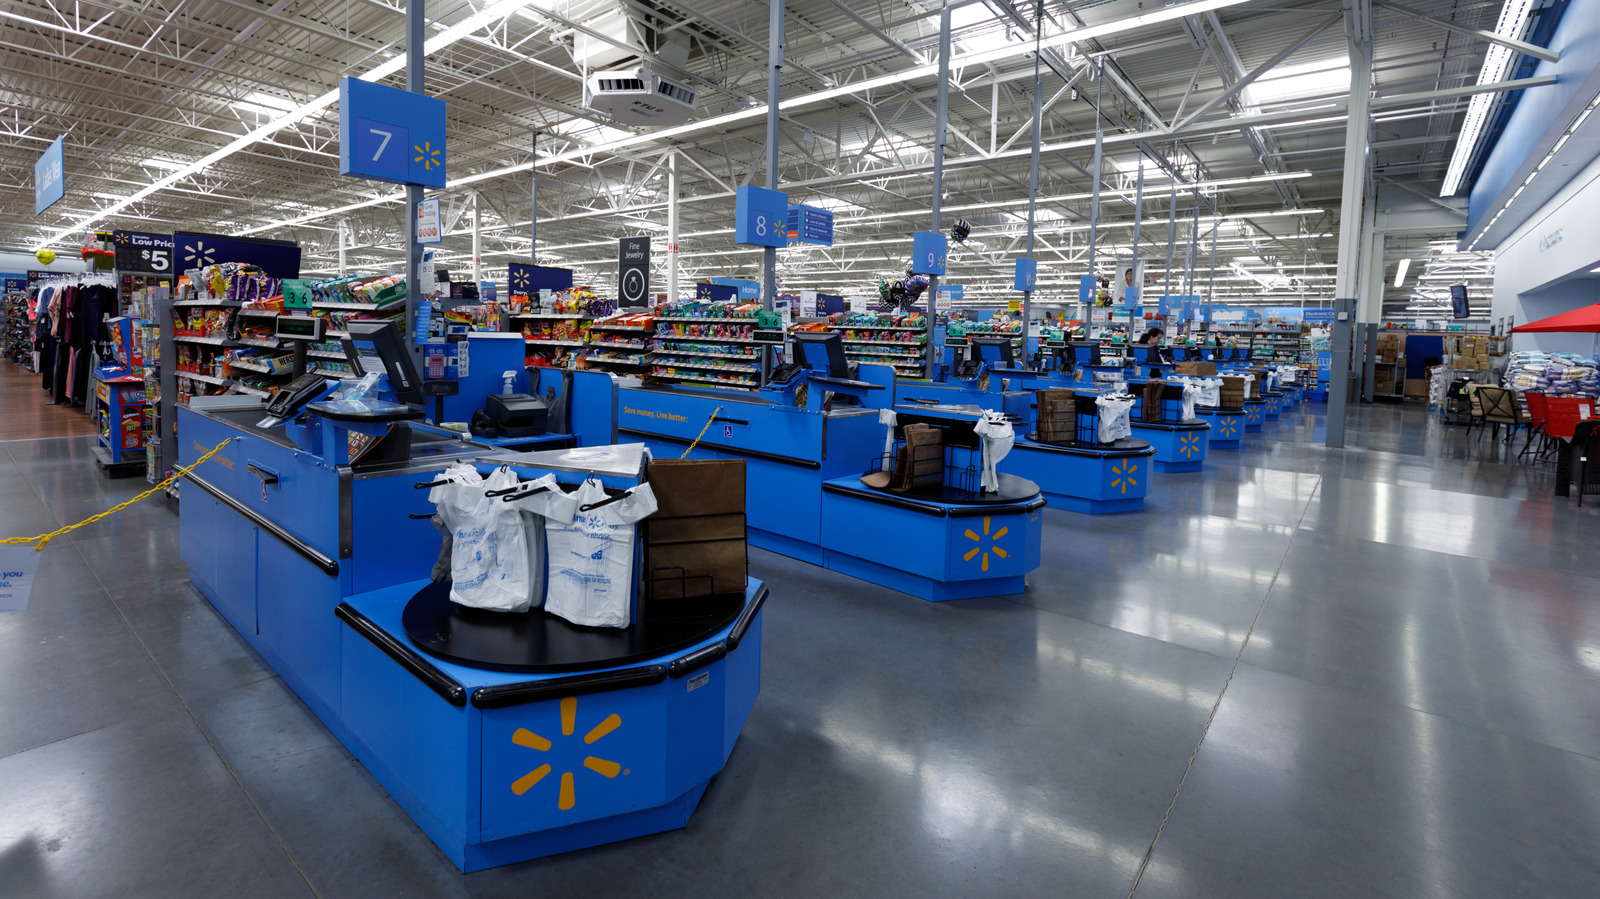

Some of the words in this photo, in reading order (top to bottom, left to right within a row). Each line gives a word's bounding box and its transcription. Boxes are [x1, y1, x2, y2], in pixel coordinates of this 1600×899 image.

[369, 128, 392, 162] 7
[756, 215, 767, 237] 8
[132, 238, 153, 246] Low
[629, 242, 640, 250] Fine
[141, 249, 169, 271] $5
[625, 251, 644, 260] Jewelry
[928, 252, 935, 268] 9
[742, 286, 758, 295] Home
[624, 405, 636, 415] Save
[637, 409, 655, 419] money.
[656, 410, 668, 420] Live
[2, 571, 24, 580] you
